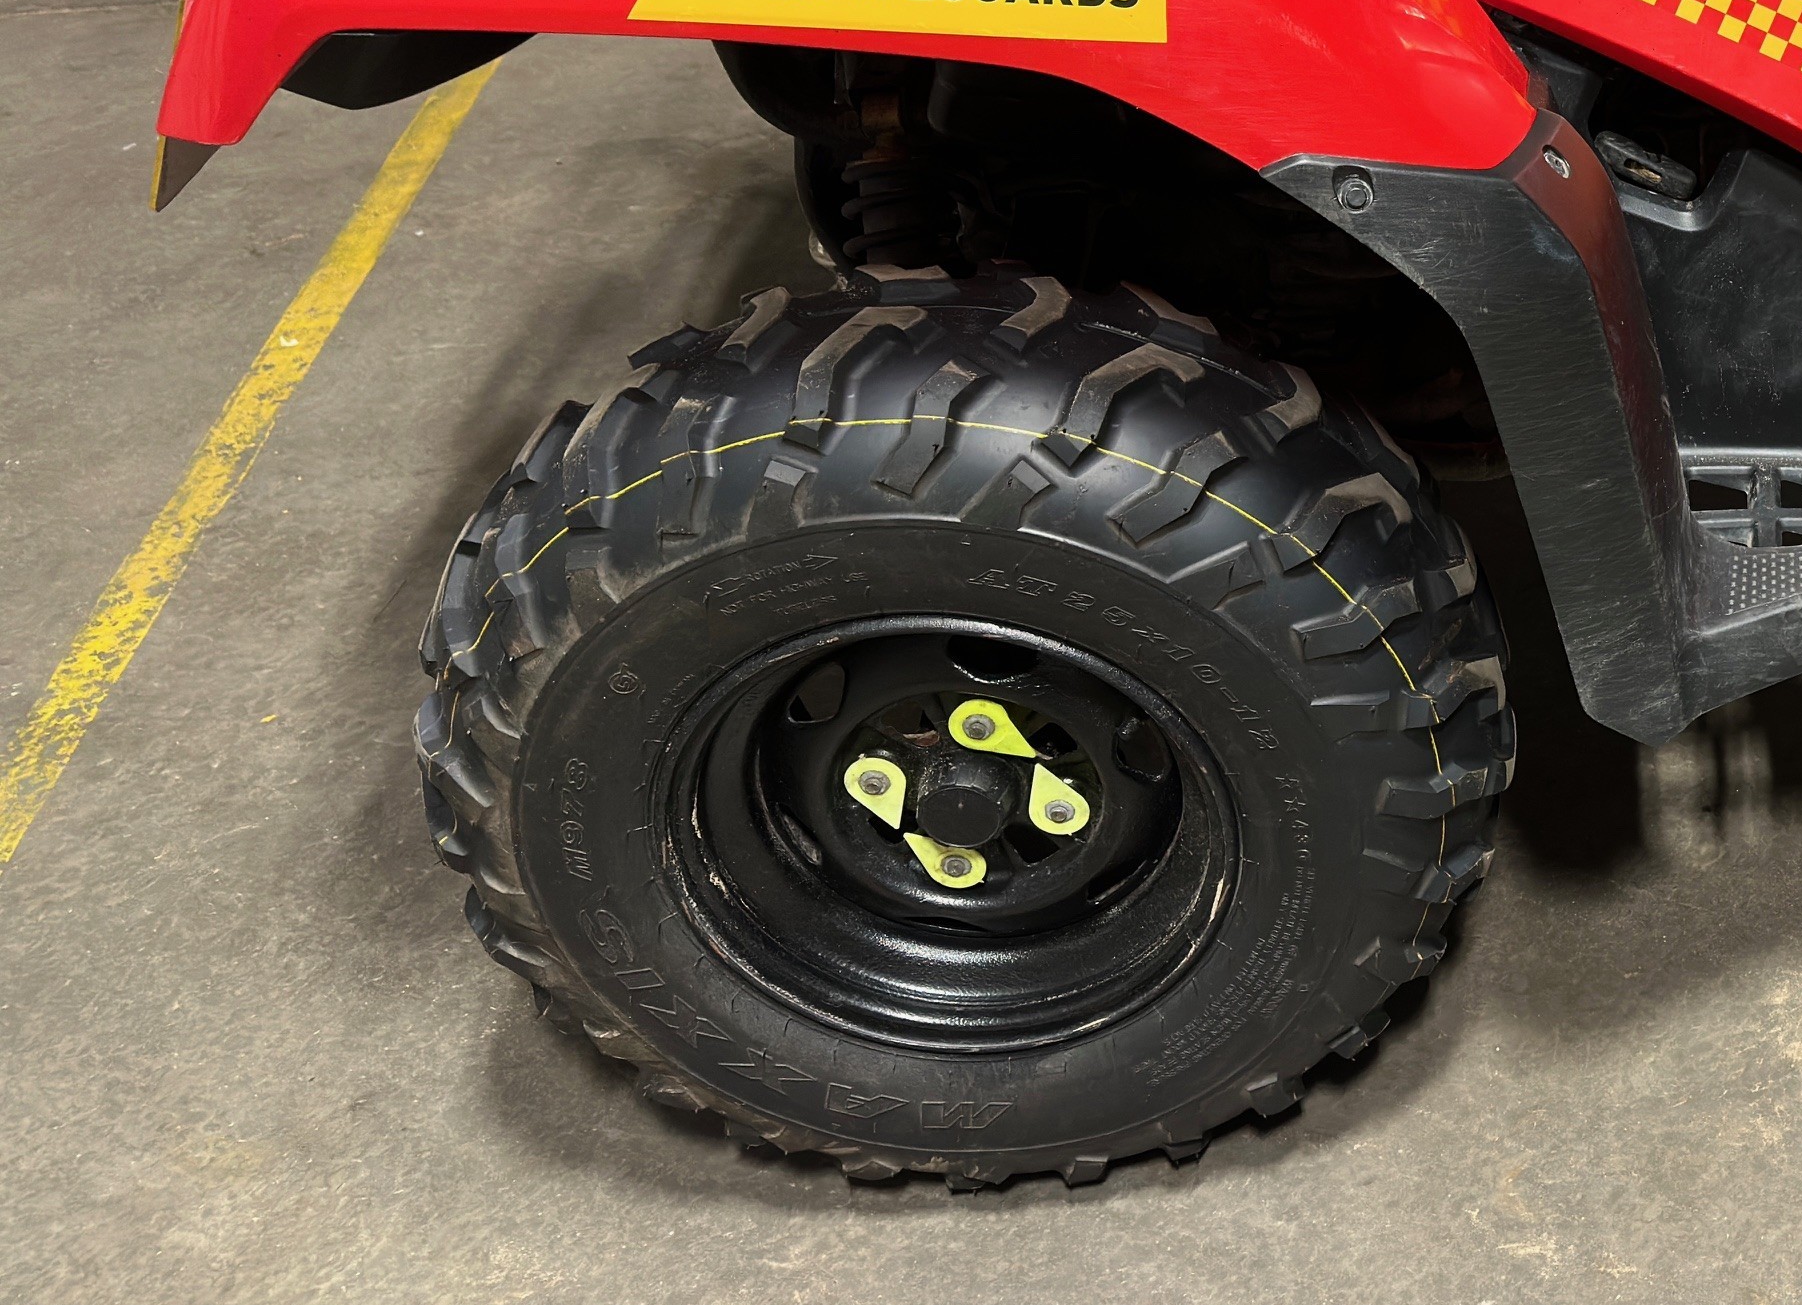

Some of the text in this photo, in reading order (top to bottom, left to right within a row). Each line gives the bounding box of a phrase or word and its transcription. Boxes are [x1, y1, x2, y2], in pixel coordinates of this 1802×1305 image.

[720, 600, 745, 617] NOT
[749, 589, 778, 604] FOR
[578, 907, 1014, 1130] MAXXIS
